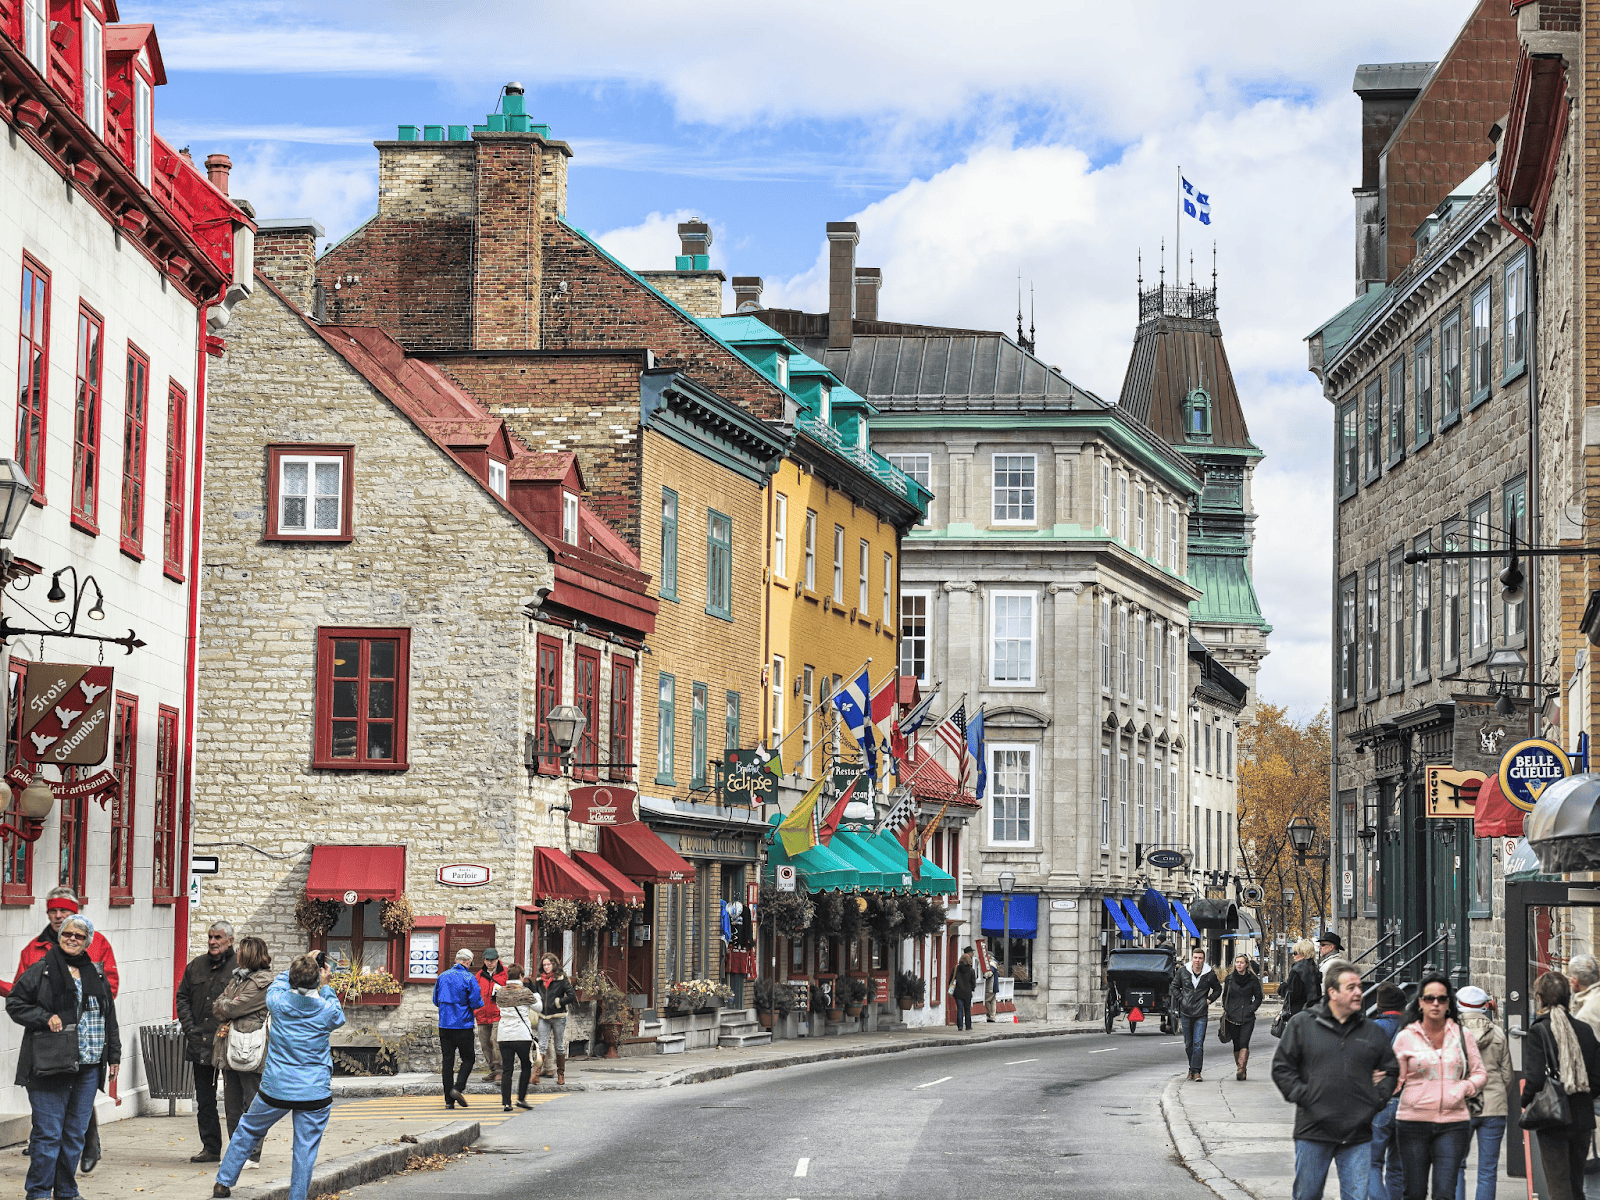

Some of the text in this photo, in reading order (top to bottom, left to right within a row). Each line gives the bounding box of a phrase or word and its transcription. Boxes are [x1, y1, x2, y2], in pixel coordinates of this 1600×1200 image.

[31, 679, 67, 713] Trois
[55, 709, 105, 761] Colombes
[1510, 767, 1562, 779] GUEULE
[1516, 756, 1555, 768] BELLE
[727, 769, 773, 797] Eclipse
[1430, 770, 1439, 813] SUSHI
[1138, 996, 1144, 1005] 6
